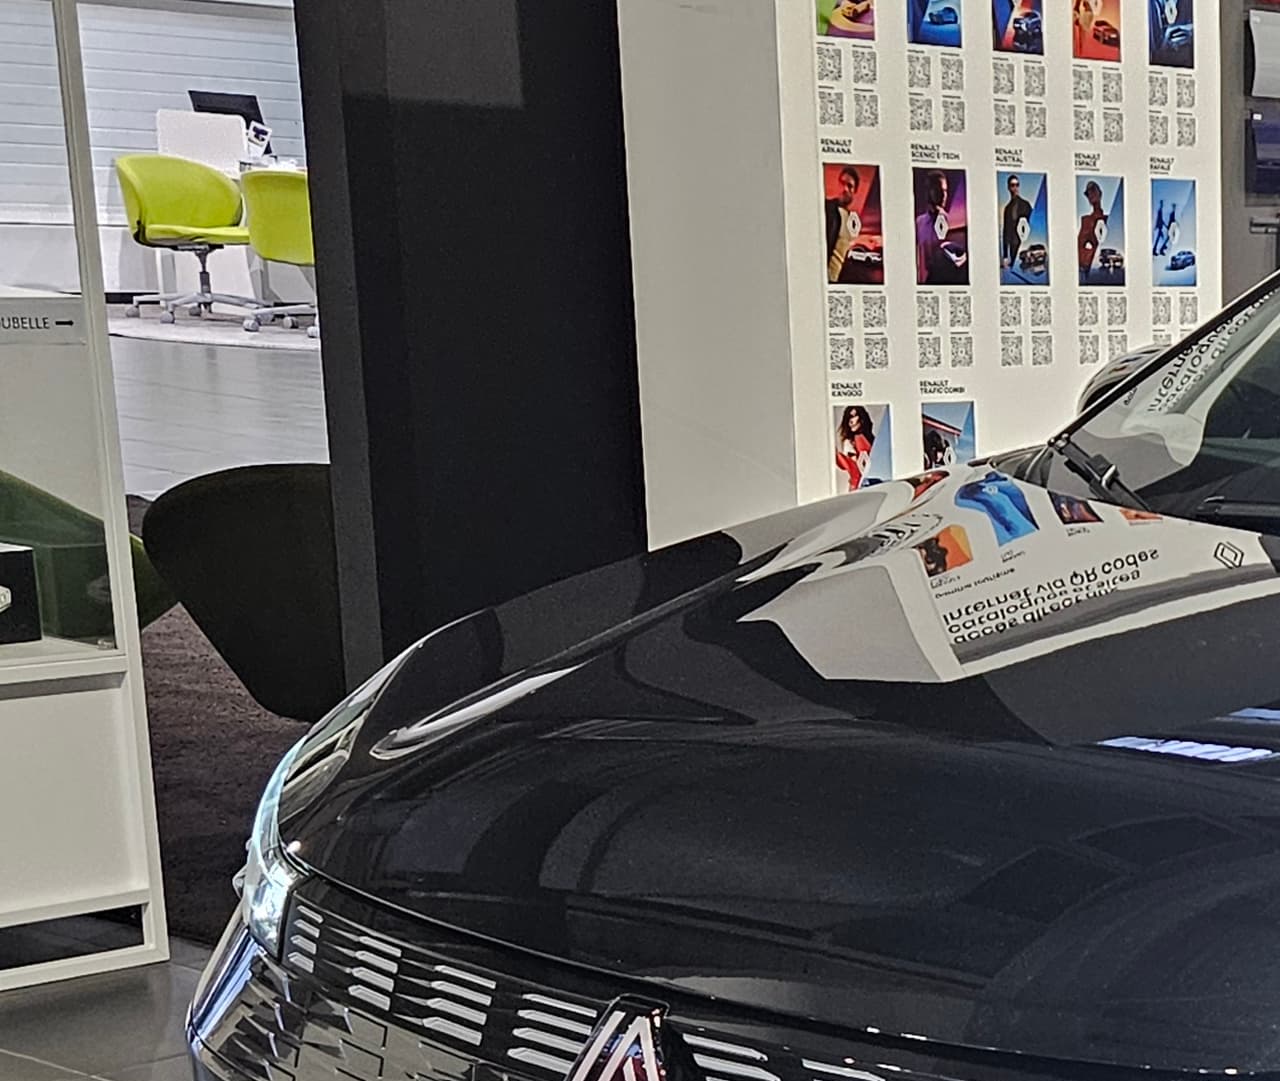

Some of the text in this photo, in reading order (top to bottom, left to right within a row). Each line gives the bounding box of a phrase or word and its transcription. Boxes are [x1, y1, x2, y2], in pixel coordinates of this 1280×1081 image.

[820, 138, 852, 147] RENAULT
[910, 143, 940, 151] RENAULT
[0, 316, 51, 330] UBELLE
[831, 382, 862, 390] RENAULT
[920, 380, 948, 388] RENAULT
